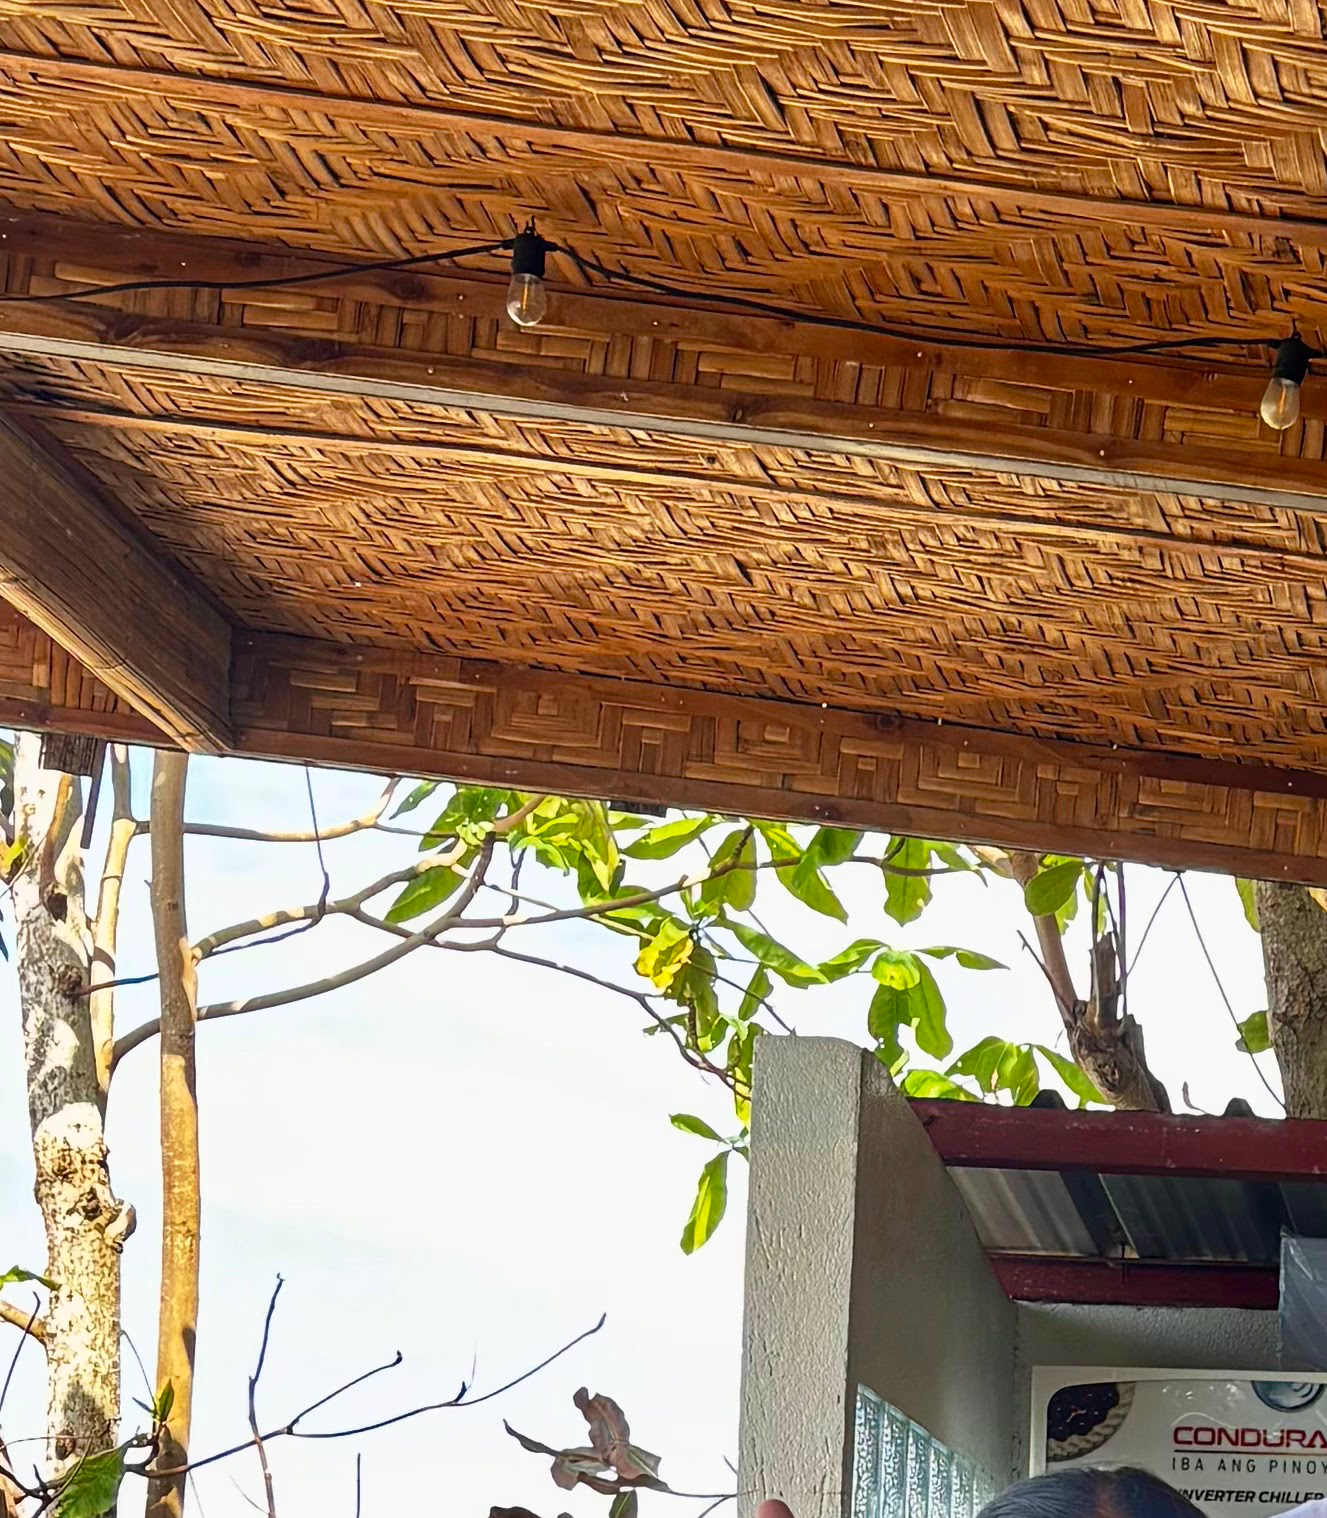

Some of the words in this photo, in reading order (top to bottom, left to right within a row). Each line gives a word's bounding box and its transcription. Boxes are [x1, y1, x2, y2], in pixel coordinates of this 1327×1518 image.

[1172, 1457, 1204, 1471] IBA
[1218, 1459, 1256, 1473] ANG
[1179, 1489, 1256, 1502] NVERTER
